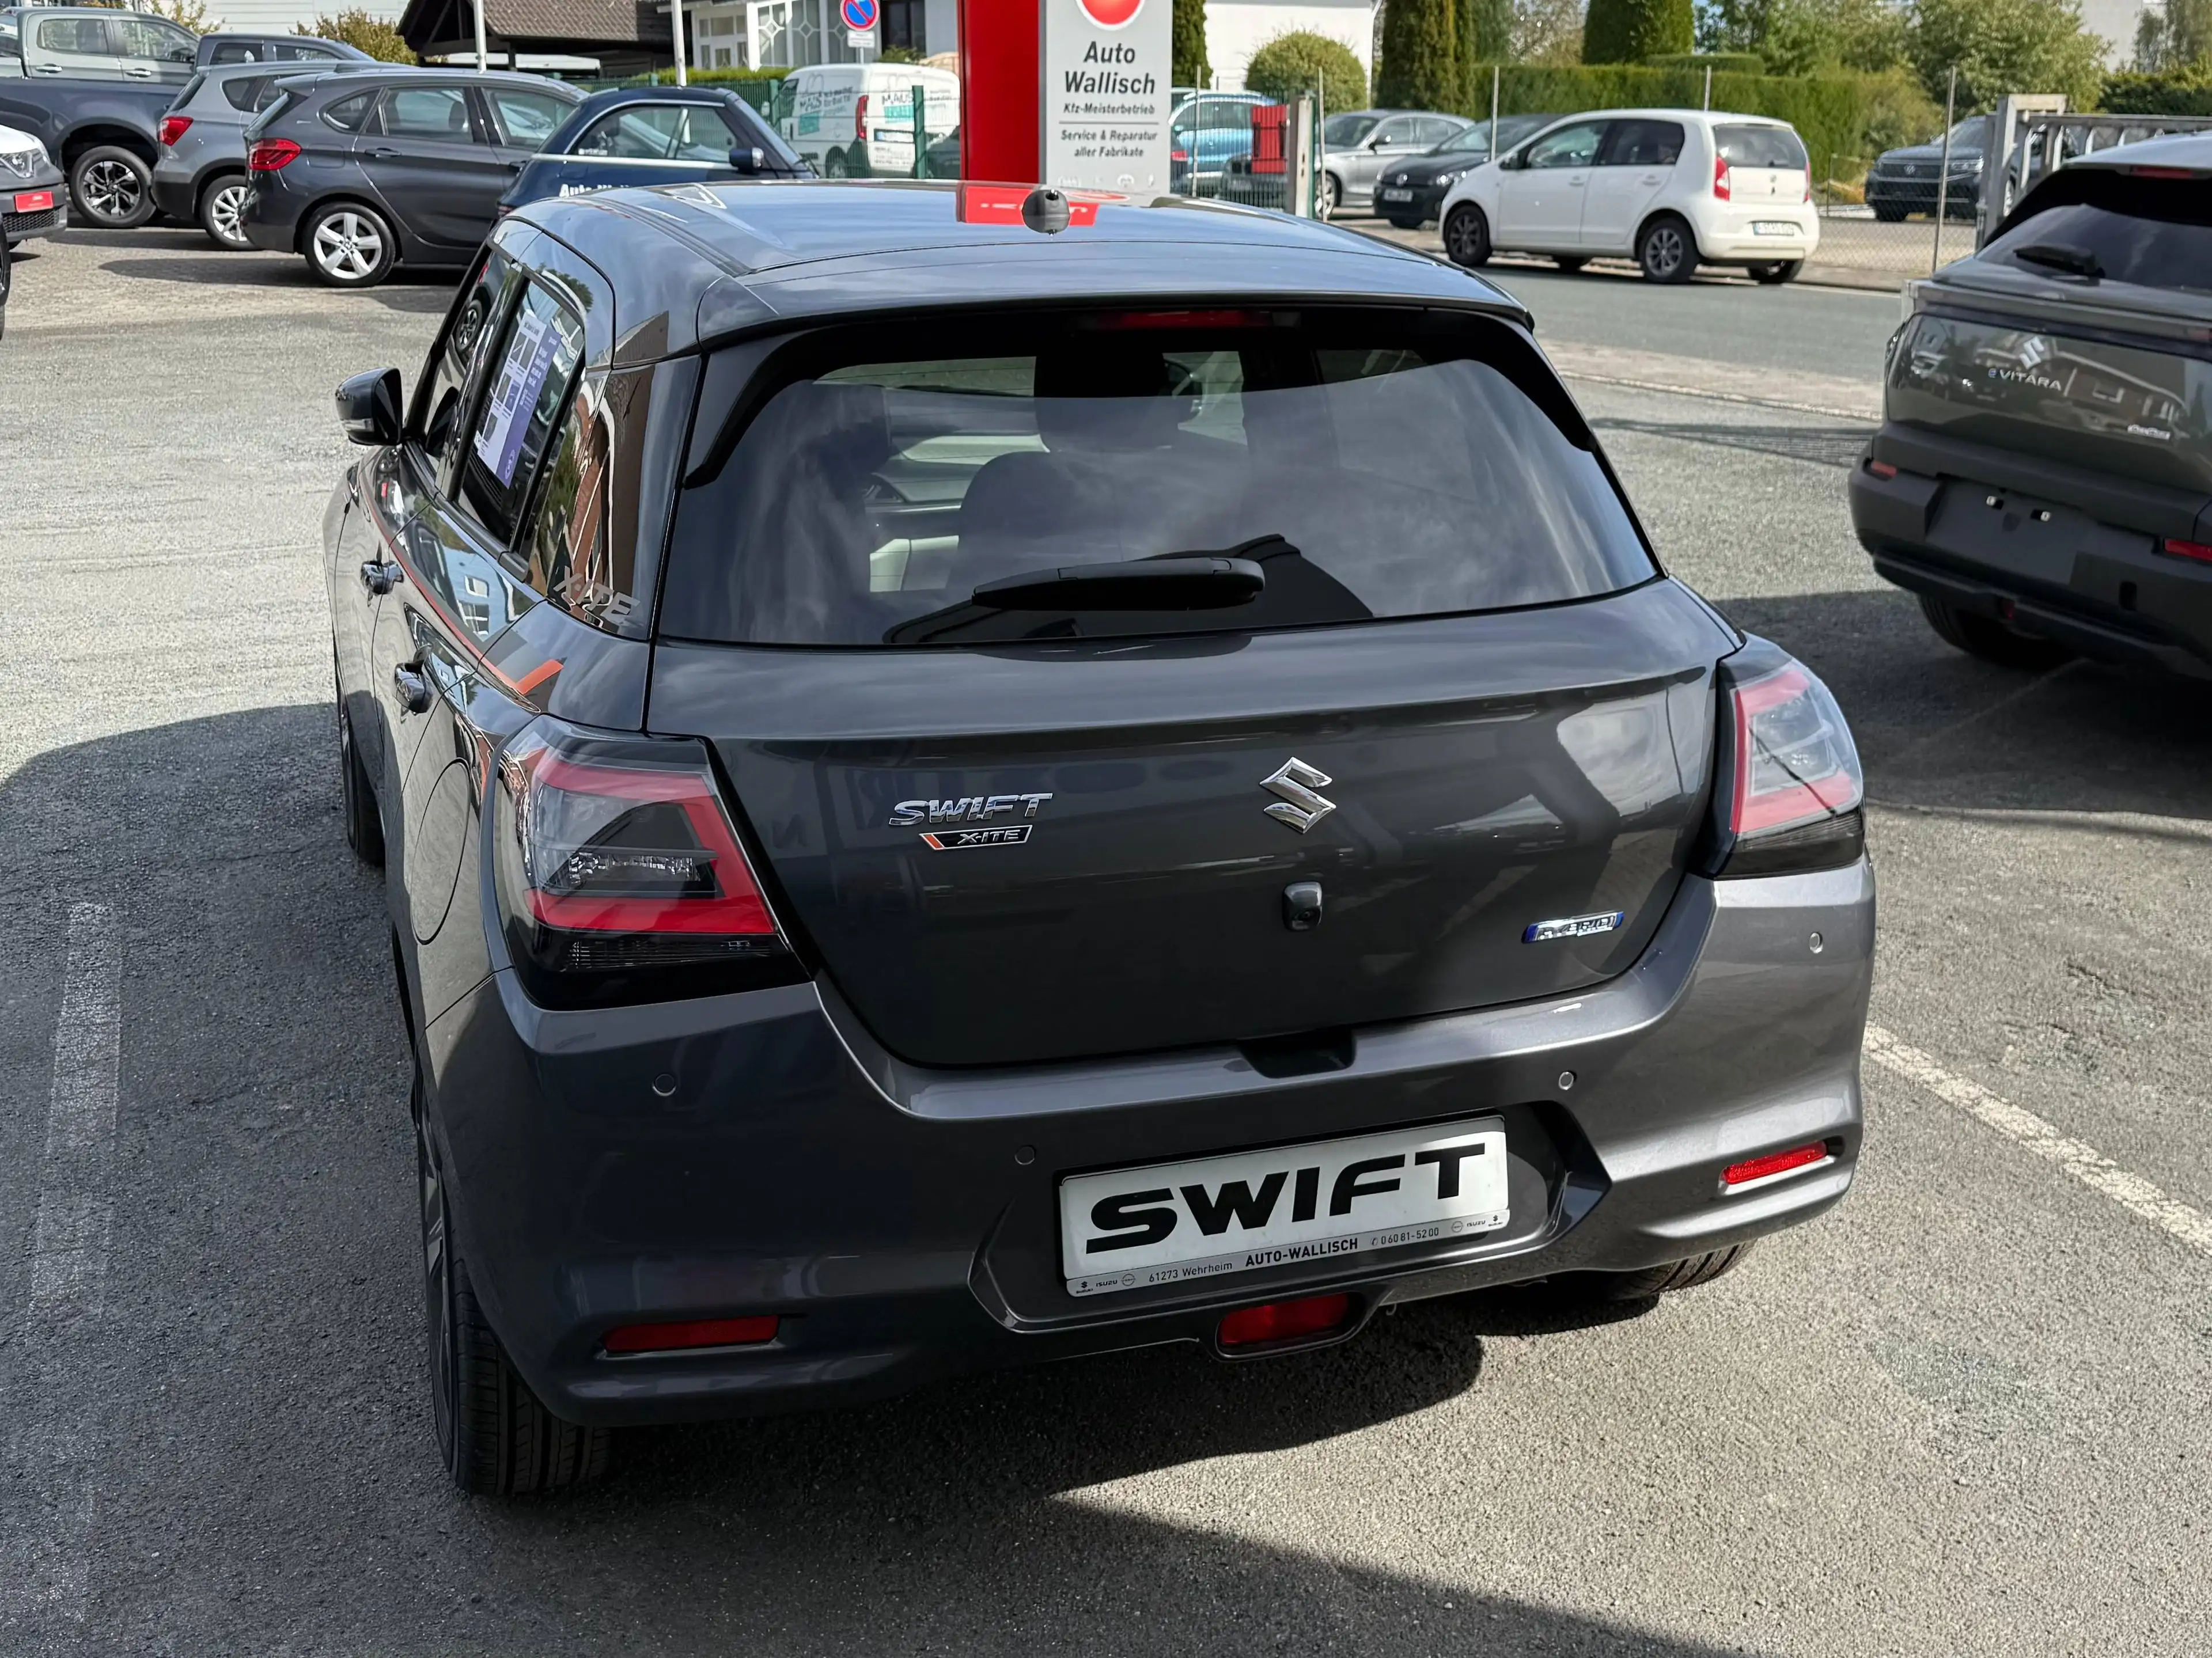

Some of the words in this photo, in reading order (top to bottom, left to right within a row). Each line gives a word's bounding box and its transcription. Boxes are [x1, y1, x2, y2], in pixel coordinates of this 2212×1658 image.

[1083, 41, 1135, 64] Auto
[1065, 71, 1155, 94] Wallisch
[1063, 103, 1155, 114] Kfz-Meisterbetrieb
[1061, 130, 1096, 141] Service
[1101, 130, 1106, 140] &
[1110, 130, 1157, 142] Reparatur
[1074, 146, 1096, 157] aller
[1099, 146, 1143, 157] Fabrikate
[1999, 369, 2061, 391] VITARA
[889, 793, 1053, 825] SWIFT
[957, 829, 1021, 845] X-ITE
[1086, 1143, 1485, 1254] SWIFT
[1149, 1270, 1179, 1283] 61273
[1183, 1262, 1233, 1276] Wehrheim
[1245, 1238, 1358, 1267] AUTO-WALLISCH
[1096, 1279, 1118, 1287] ISUZU
